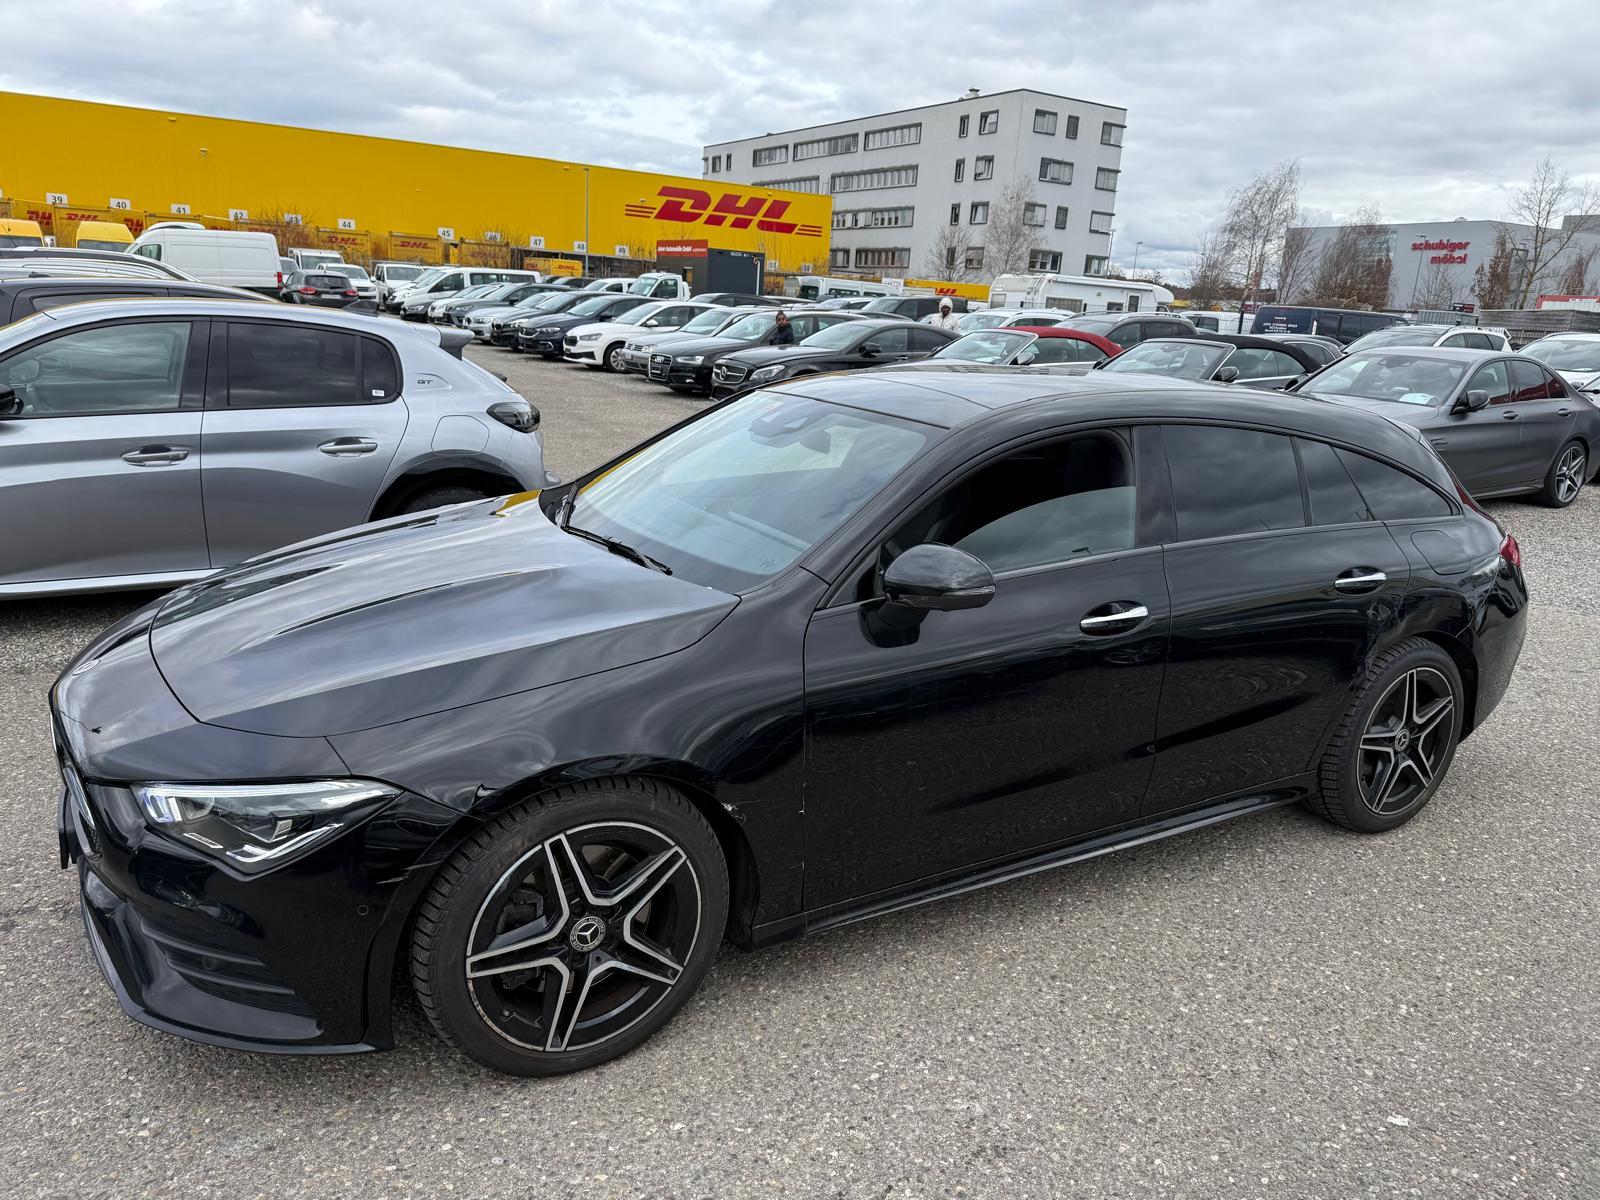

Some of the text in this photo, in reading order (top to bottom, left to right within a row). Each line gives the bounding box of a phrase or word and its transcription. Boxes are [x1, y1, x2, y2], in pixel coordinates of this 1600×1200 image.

[51, 195, 63, 204] 39
[115, 201, 127, 209] 40
[176, 206, 187, 214] 41
[653, 186, 798, 234] DHL
[341, 221, 352, 229] 44
[441, 229, 451, 238] 45
[399, 241, 431, 250] DHL
[576, 243, 586, 251] 48
[1410, 239, 1471, 252] schubiger
[617, 247, 626, 255] 49
